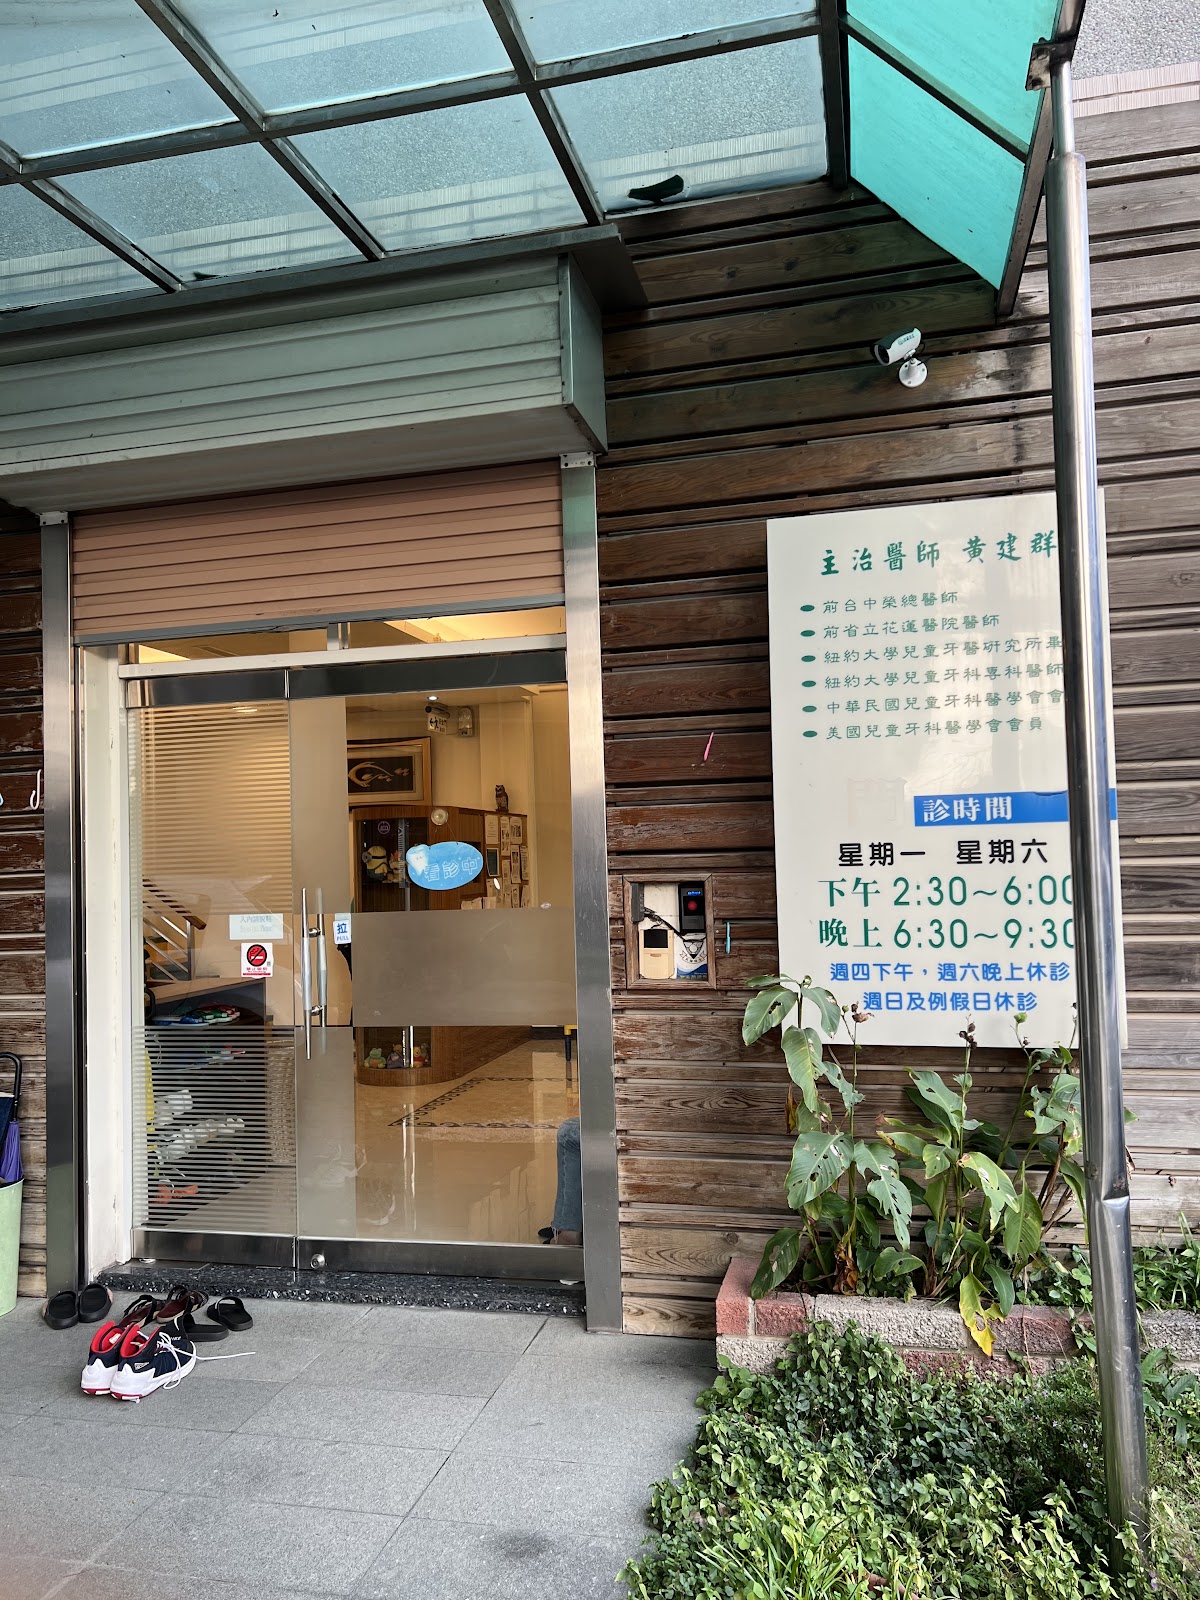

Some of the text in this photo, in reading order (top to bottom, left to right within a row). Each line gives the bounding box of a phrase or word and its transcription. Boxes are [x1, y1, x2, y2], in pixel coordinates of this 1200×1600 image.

[820, 540, 941, 576] 主治醫師
[822, 591, 958, 614] 前台中榮總醫師
[823, 614, 1000, 639] 前省立花蓮醫院醫師
[826, 717, 1043, 740] 美國兒童牙科醫學會會員
[922, 796, 1013, 823] 診時間
[838, 839, 1048, 867] 星期一 星期六
[424, 857, 478, 882] 看診中
[817, 877, 881, 908] 下午
[336, 922, 348, 935] 拉
[818, 918, 883, 948] 晚上
[830, 962, 1070, 982] 週四下午，週六晚上休診
[863, 991, 1038, 1011] 週日及例假日休診
